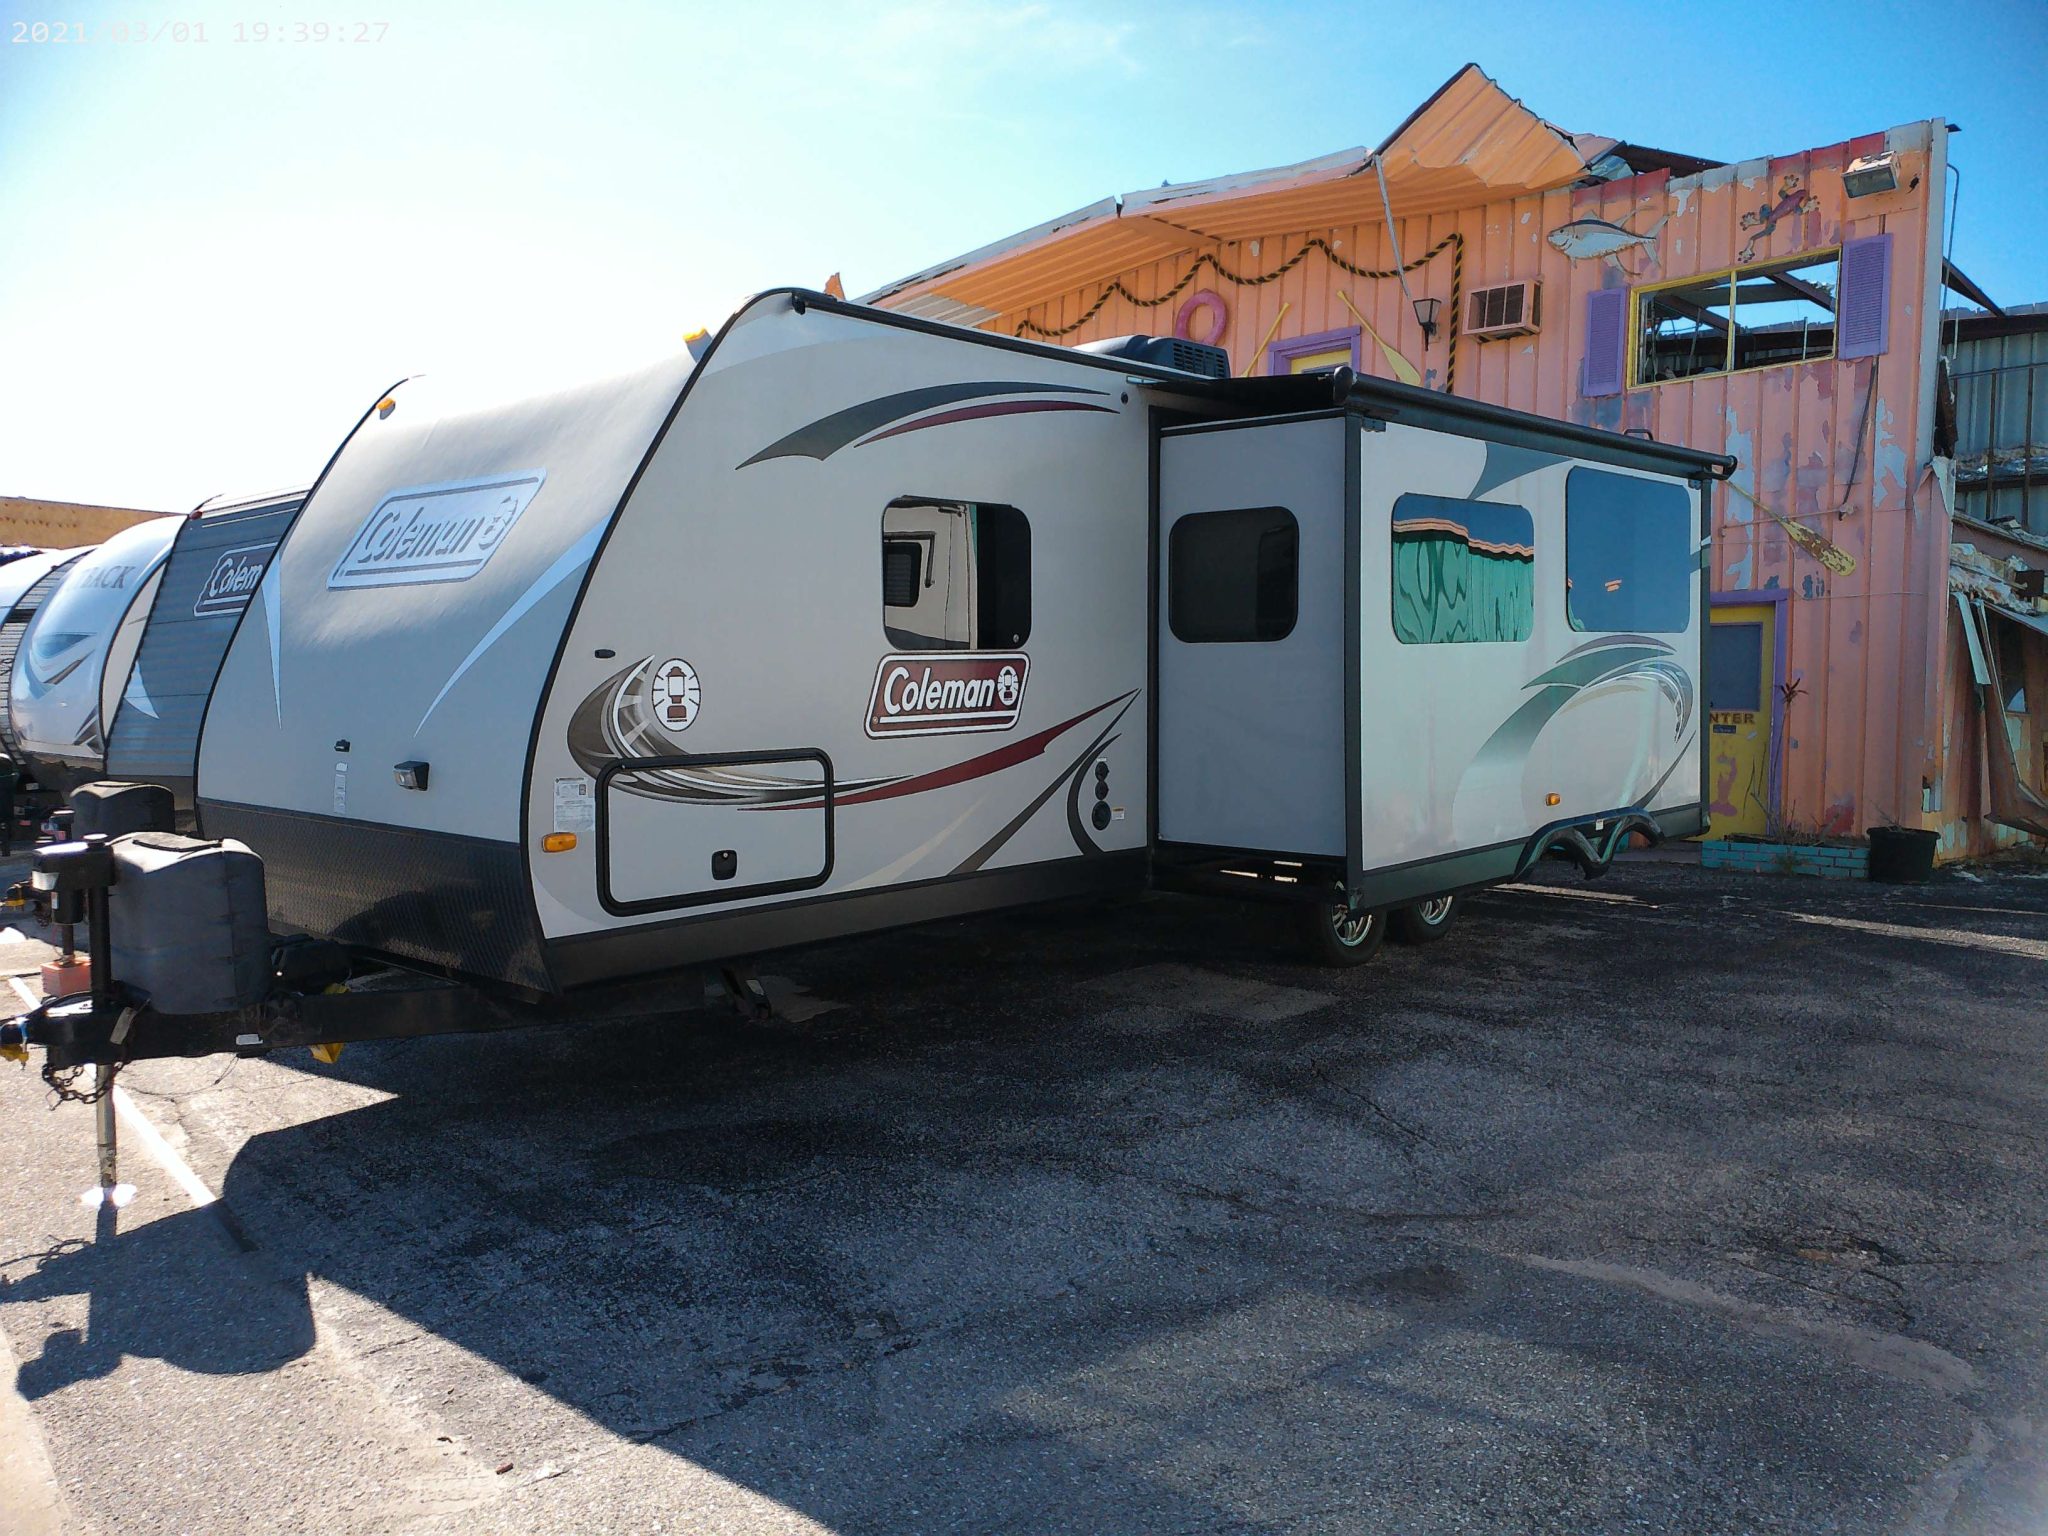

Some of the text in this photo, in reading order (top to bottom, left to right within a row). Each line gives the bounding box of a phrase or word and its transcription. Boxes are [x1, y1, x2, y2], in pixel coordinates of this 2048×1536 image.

[357, 506, 486, 564] Coleman
[208, 555, 264, 598] Colem
[883, 666, 996, 715] Coleman
[1709, 712, 1756, 725] NTER
